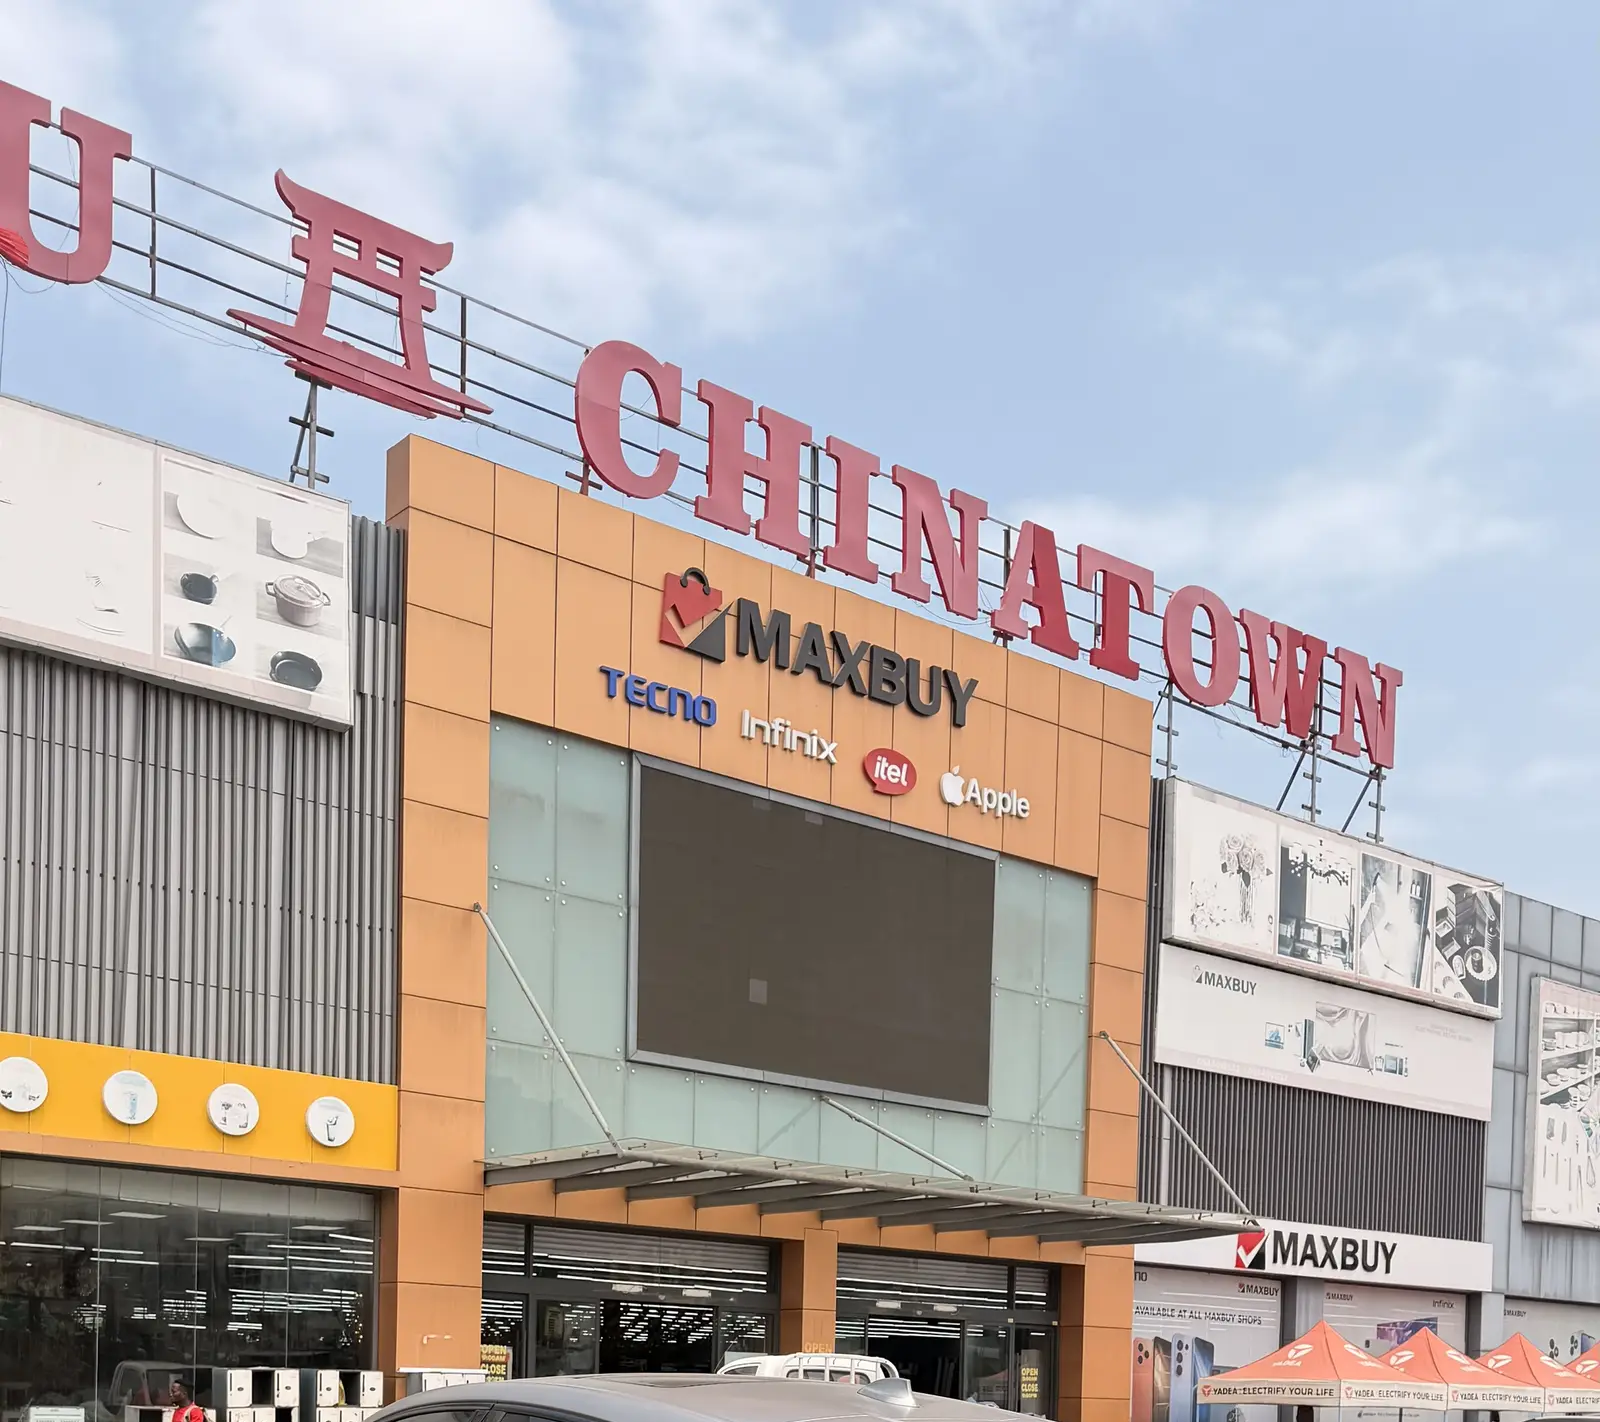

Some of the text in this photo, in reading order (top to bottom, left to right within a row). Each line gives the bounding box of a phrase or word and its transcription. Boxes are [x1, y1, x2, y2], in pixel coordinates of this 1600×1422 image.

[574, 340, 1404, 769] CHINATOWN
[736, 597, 978, 727] MAXBUY
[599, 665, 717, 727] TECNO
[741, 709, 839, 765] Infinix
[873, 754, 909, 788] itel
[965, 777, 1030, 819] Apple
[1204, 970, 1257, 996] MAXBUY
[1271, 1230, 1397, 1275] MAXBUY
[1245, 1284, 1280, 1297] MAXBUY
[1331, 1292, 1354, 1302] MAXBUY
[1135, 1305, 1262, 1325] AVAILABLE AT ALL MAXBUY SHOPS
[1213, 1386, 1335, 1397] YADEA ELECTRIFY YOUR LIFE
[1354, 1389, 1444, 1402] YADEA ELECTRIFY YOUR LIFE
[1460, 1393, 1479, 1401] YADEA
[1481, 1393, 1512, 1402] ELECTRIFY
[1513, 1395, 1529, 1404] YOUR
[1555, 1396, 1573, 1404] YADEA
